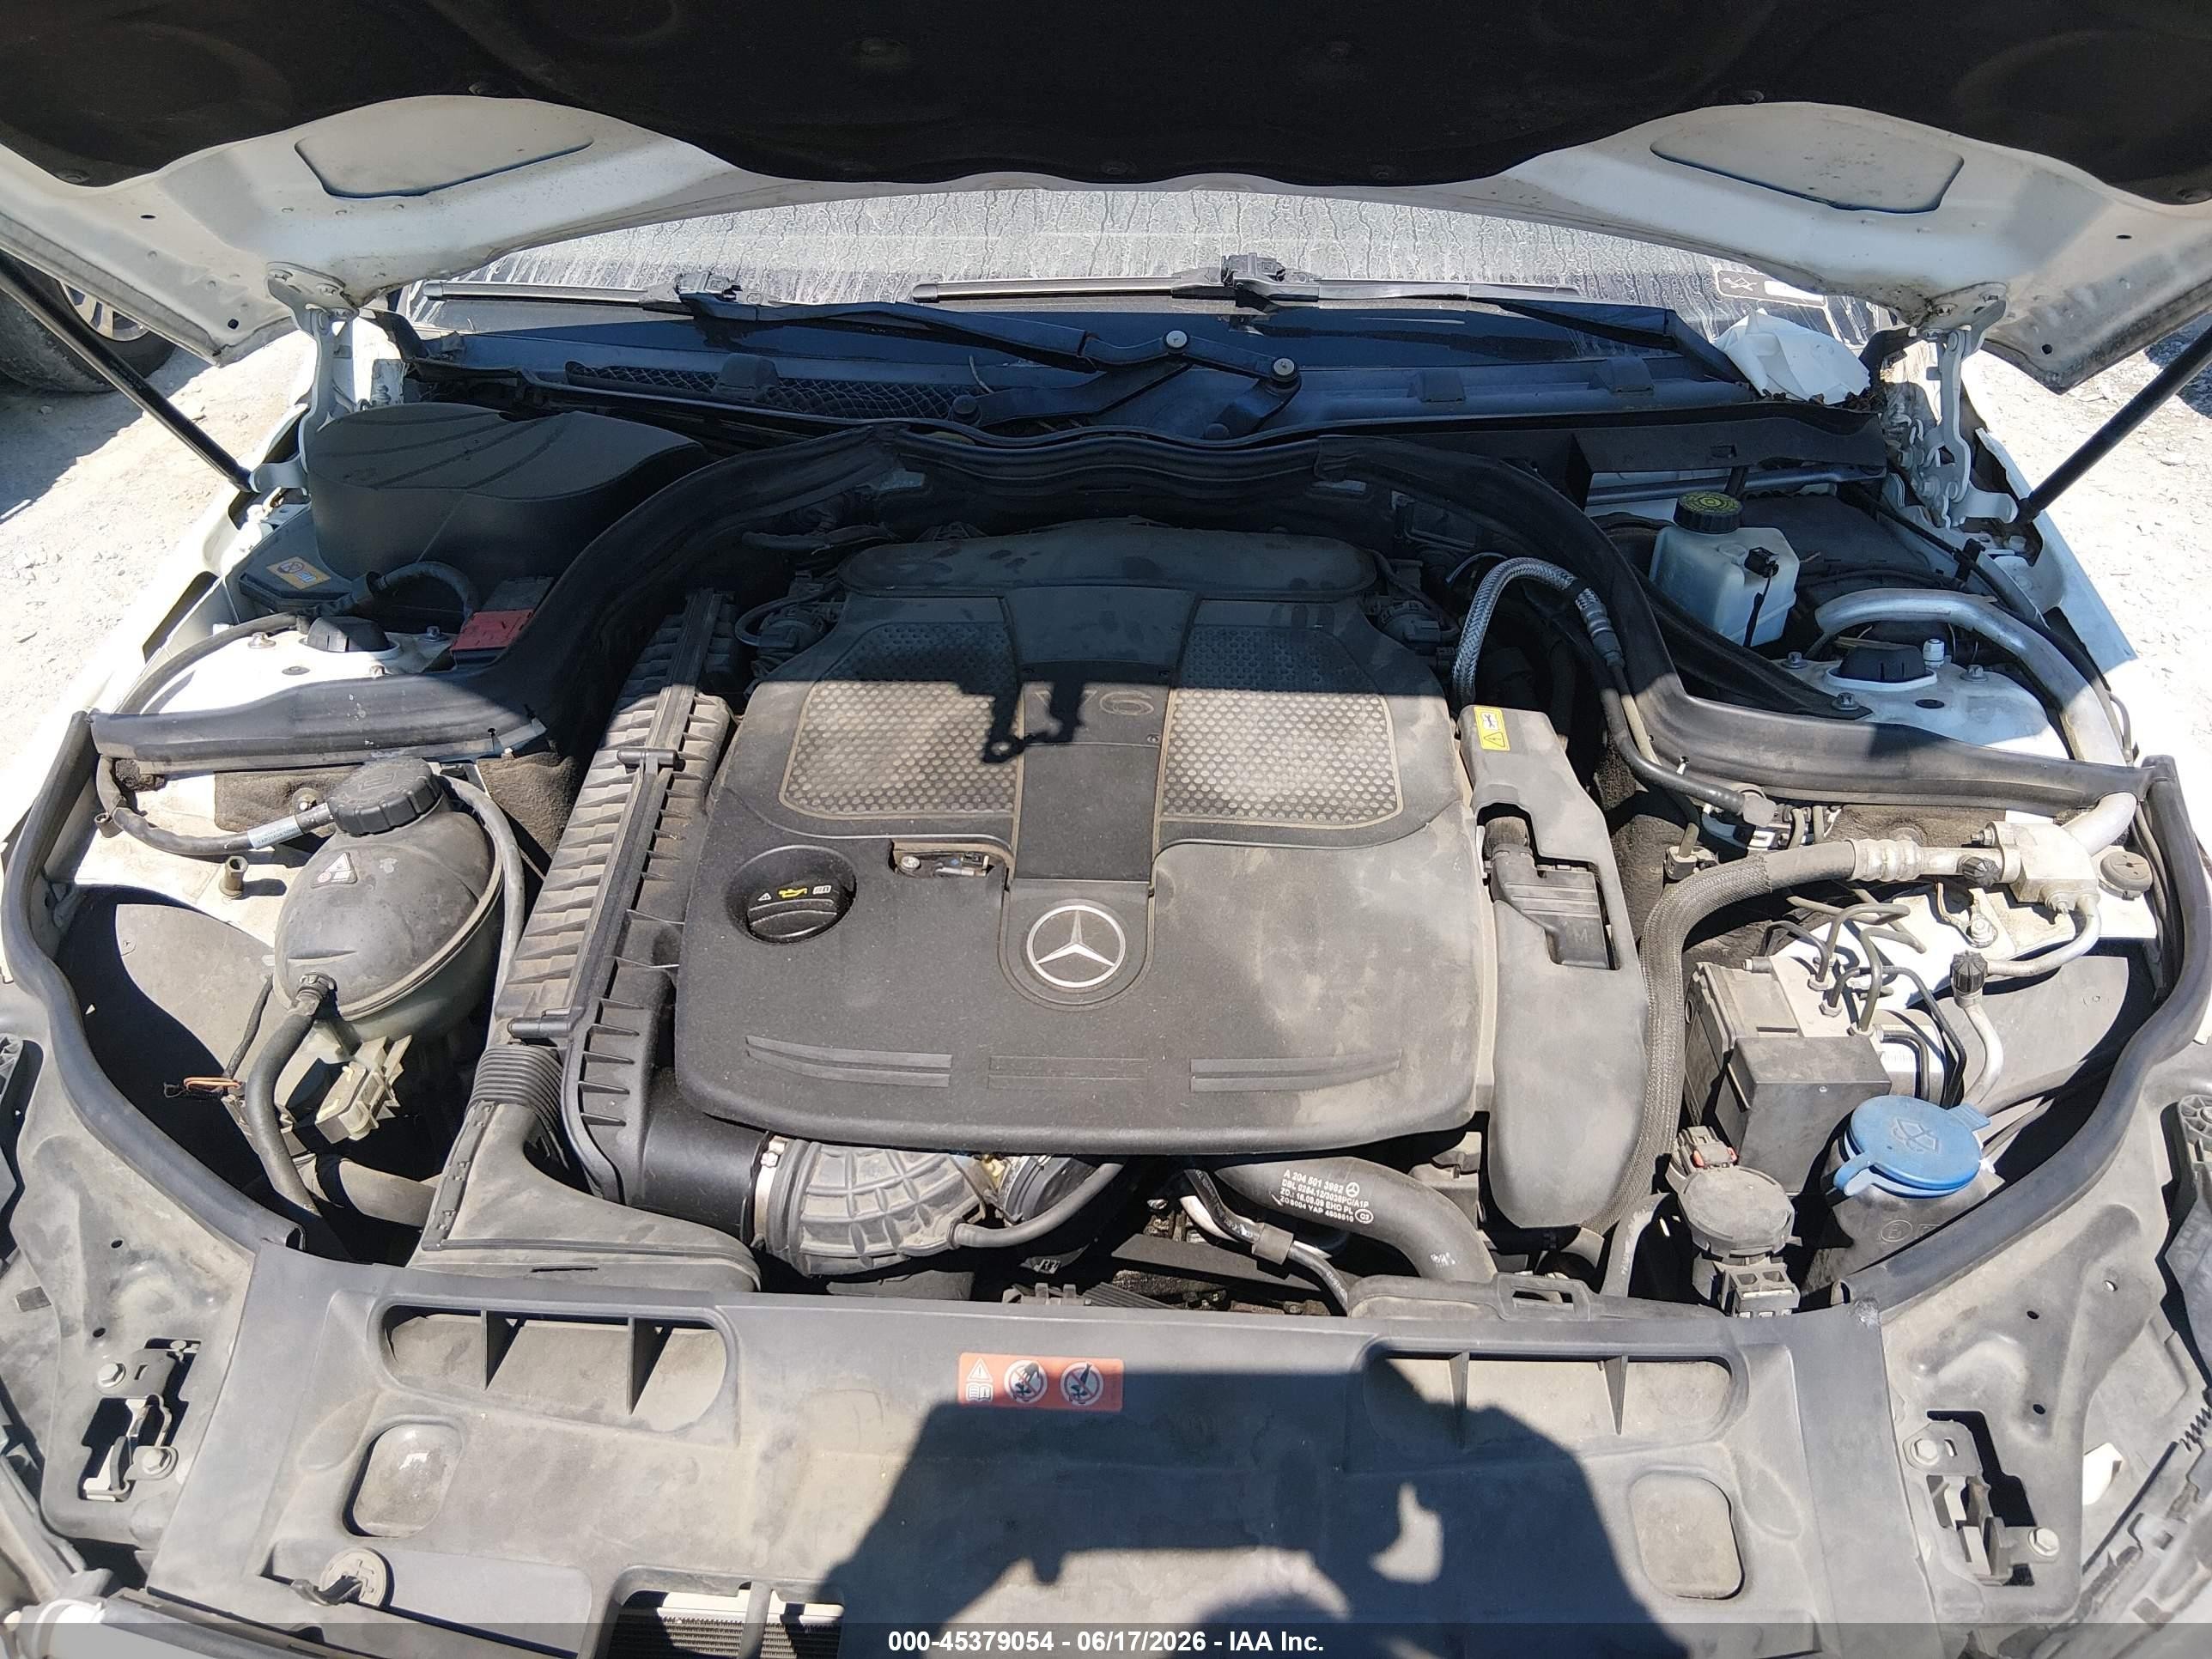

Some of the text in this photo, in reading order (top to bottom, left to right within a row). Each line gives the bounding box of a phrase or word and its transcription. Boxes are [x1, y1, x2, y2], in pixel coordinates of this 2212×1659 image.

[1284, 1169, 1291, 1178] A
[1292, 1172, 1307, 1182] 204
[1308, 1176, 1322, 1186] 501
[1282, 1179, 1296, 1190] DBL
[1343, 1206, 1354, 1216] PL
